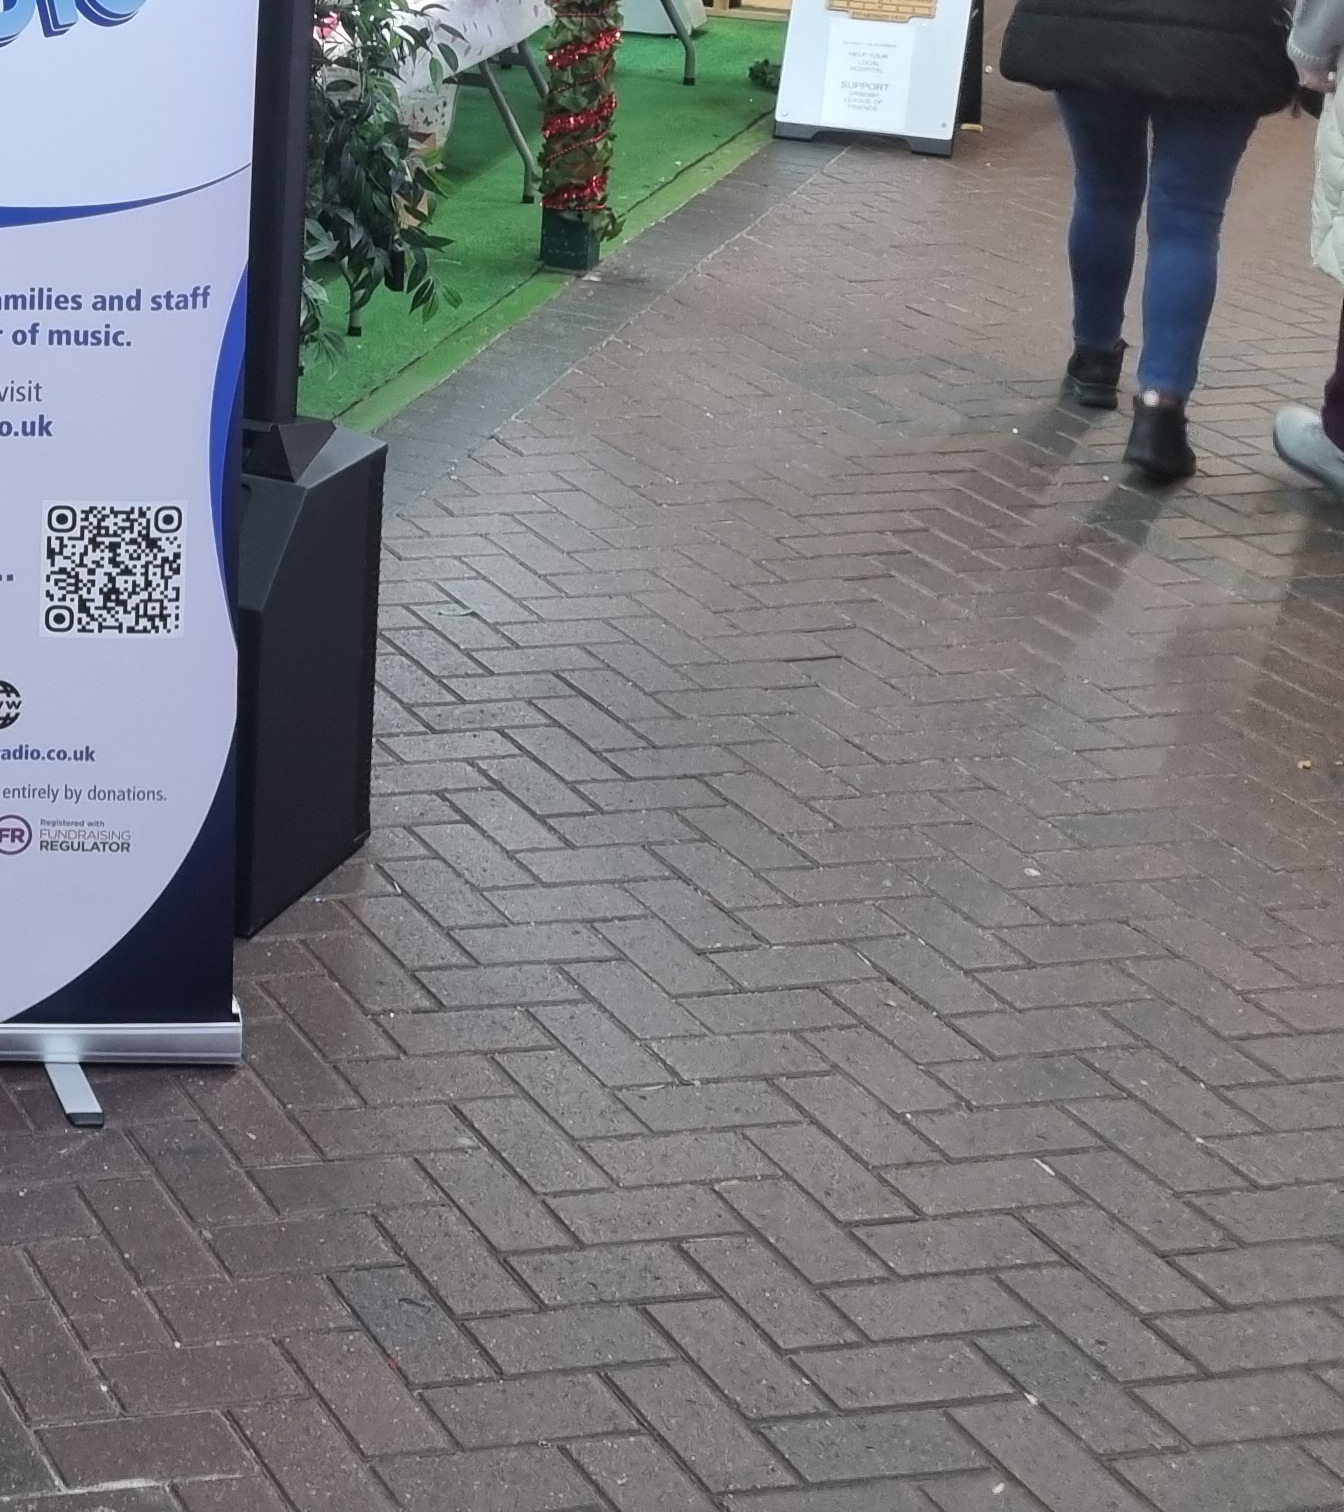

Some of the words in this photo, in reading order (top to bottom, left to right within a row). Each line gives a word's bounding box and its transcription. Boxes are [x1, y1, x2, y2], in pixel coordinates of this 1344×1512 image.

[841, 81, 889, 91] SUPPORT
[91, 288, 142, 311] and
[150, 285, 211, 311] staff
[12, 322, 40, 346] of
[48, 323, 132, 347] music.
[2, 784, 59, 803] entirely
[64, 785, 82, 804] by
[87, 785, 167, 802] donations.
[40, 818, 85, 829] Registered
[87, 819, 105, 828] with
[39, 829, 132, 841] FUNDRAISING
[39, 840, 131, 853] REGULATOR
